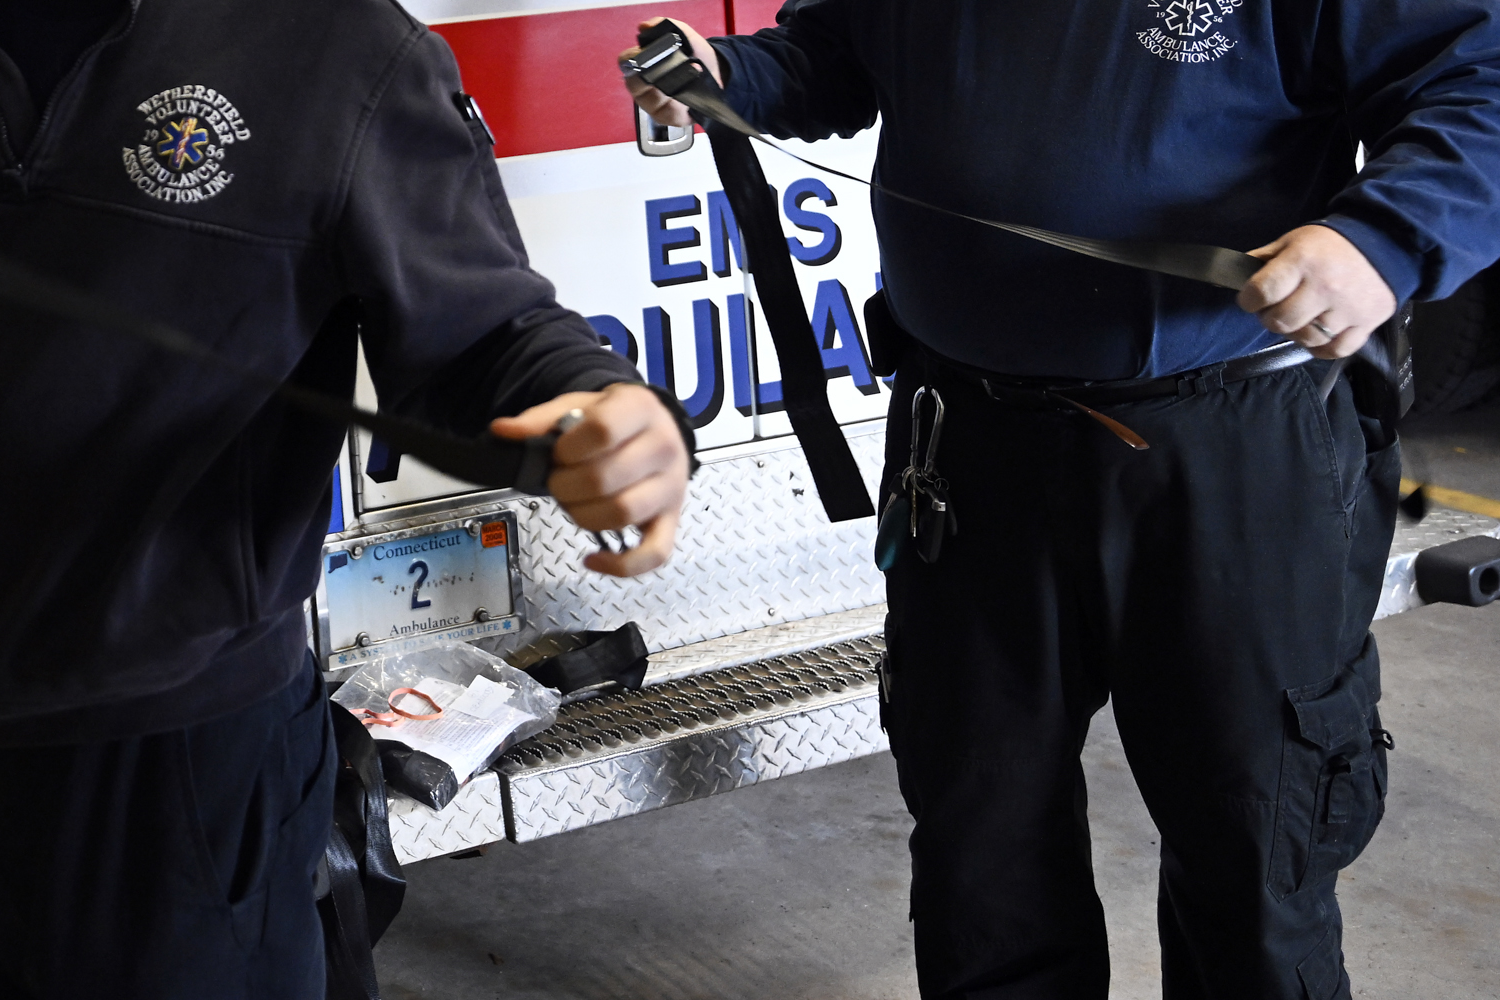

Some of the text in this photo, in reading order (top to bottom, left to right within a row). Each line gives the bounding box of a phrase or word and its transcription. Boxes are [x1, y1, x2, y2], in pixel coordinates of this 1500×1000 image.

[1212, 15, 1223, 23] 56
[1147, 26, 1225, 52] AMBULANCE
[136, 84, 251, 141] WETHERSFIELD
[145, 99, 235, 146] VOLUNTEER
[142, 128, 225, 161] 19 56
[138, 144, 221, 188] AMBULANCE
[373, 534, 461, 561] Connecticut
[408, 560, 432, 611] 2
[350, 653, 357, 661] A
[447, 627, 475, 640] YOUR
[476, 622, 500, 634] LIFE
[389, 615, 460, 636] Ambulance
